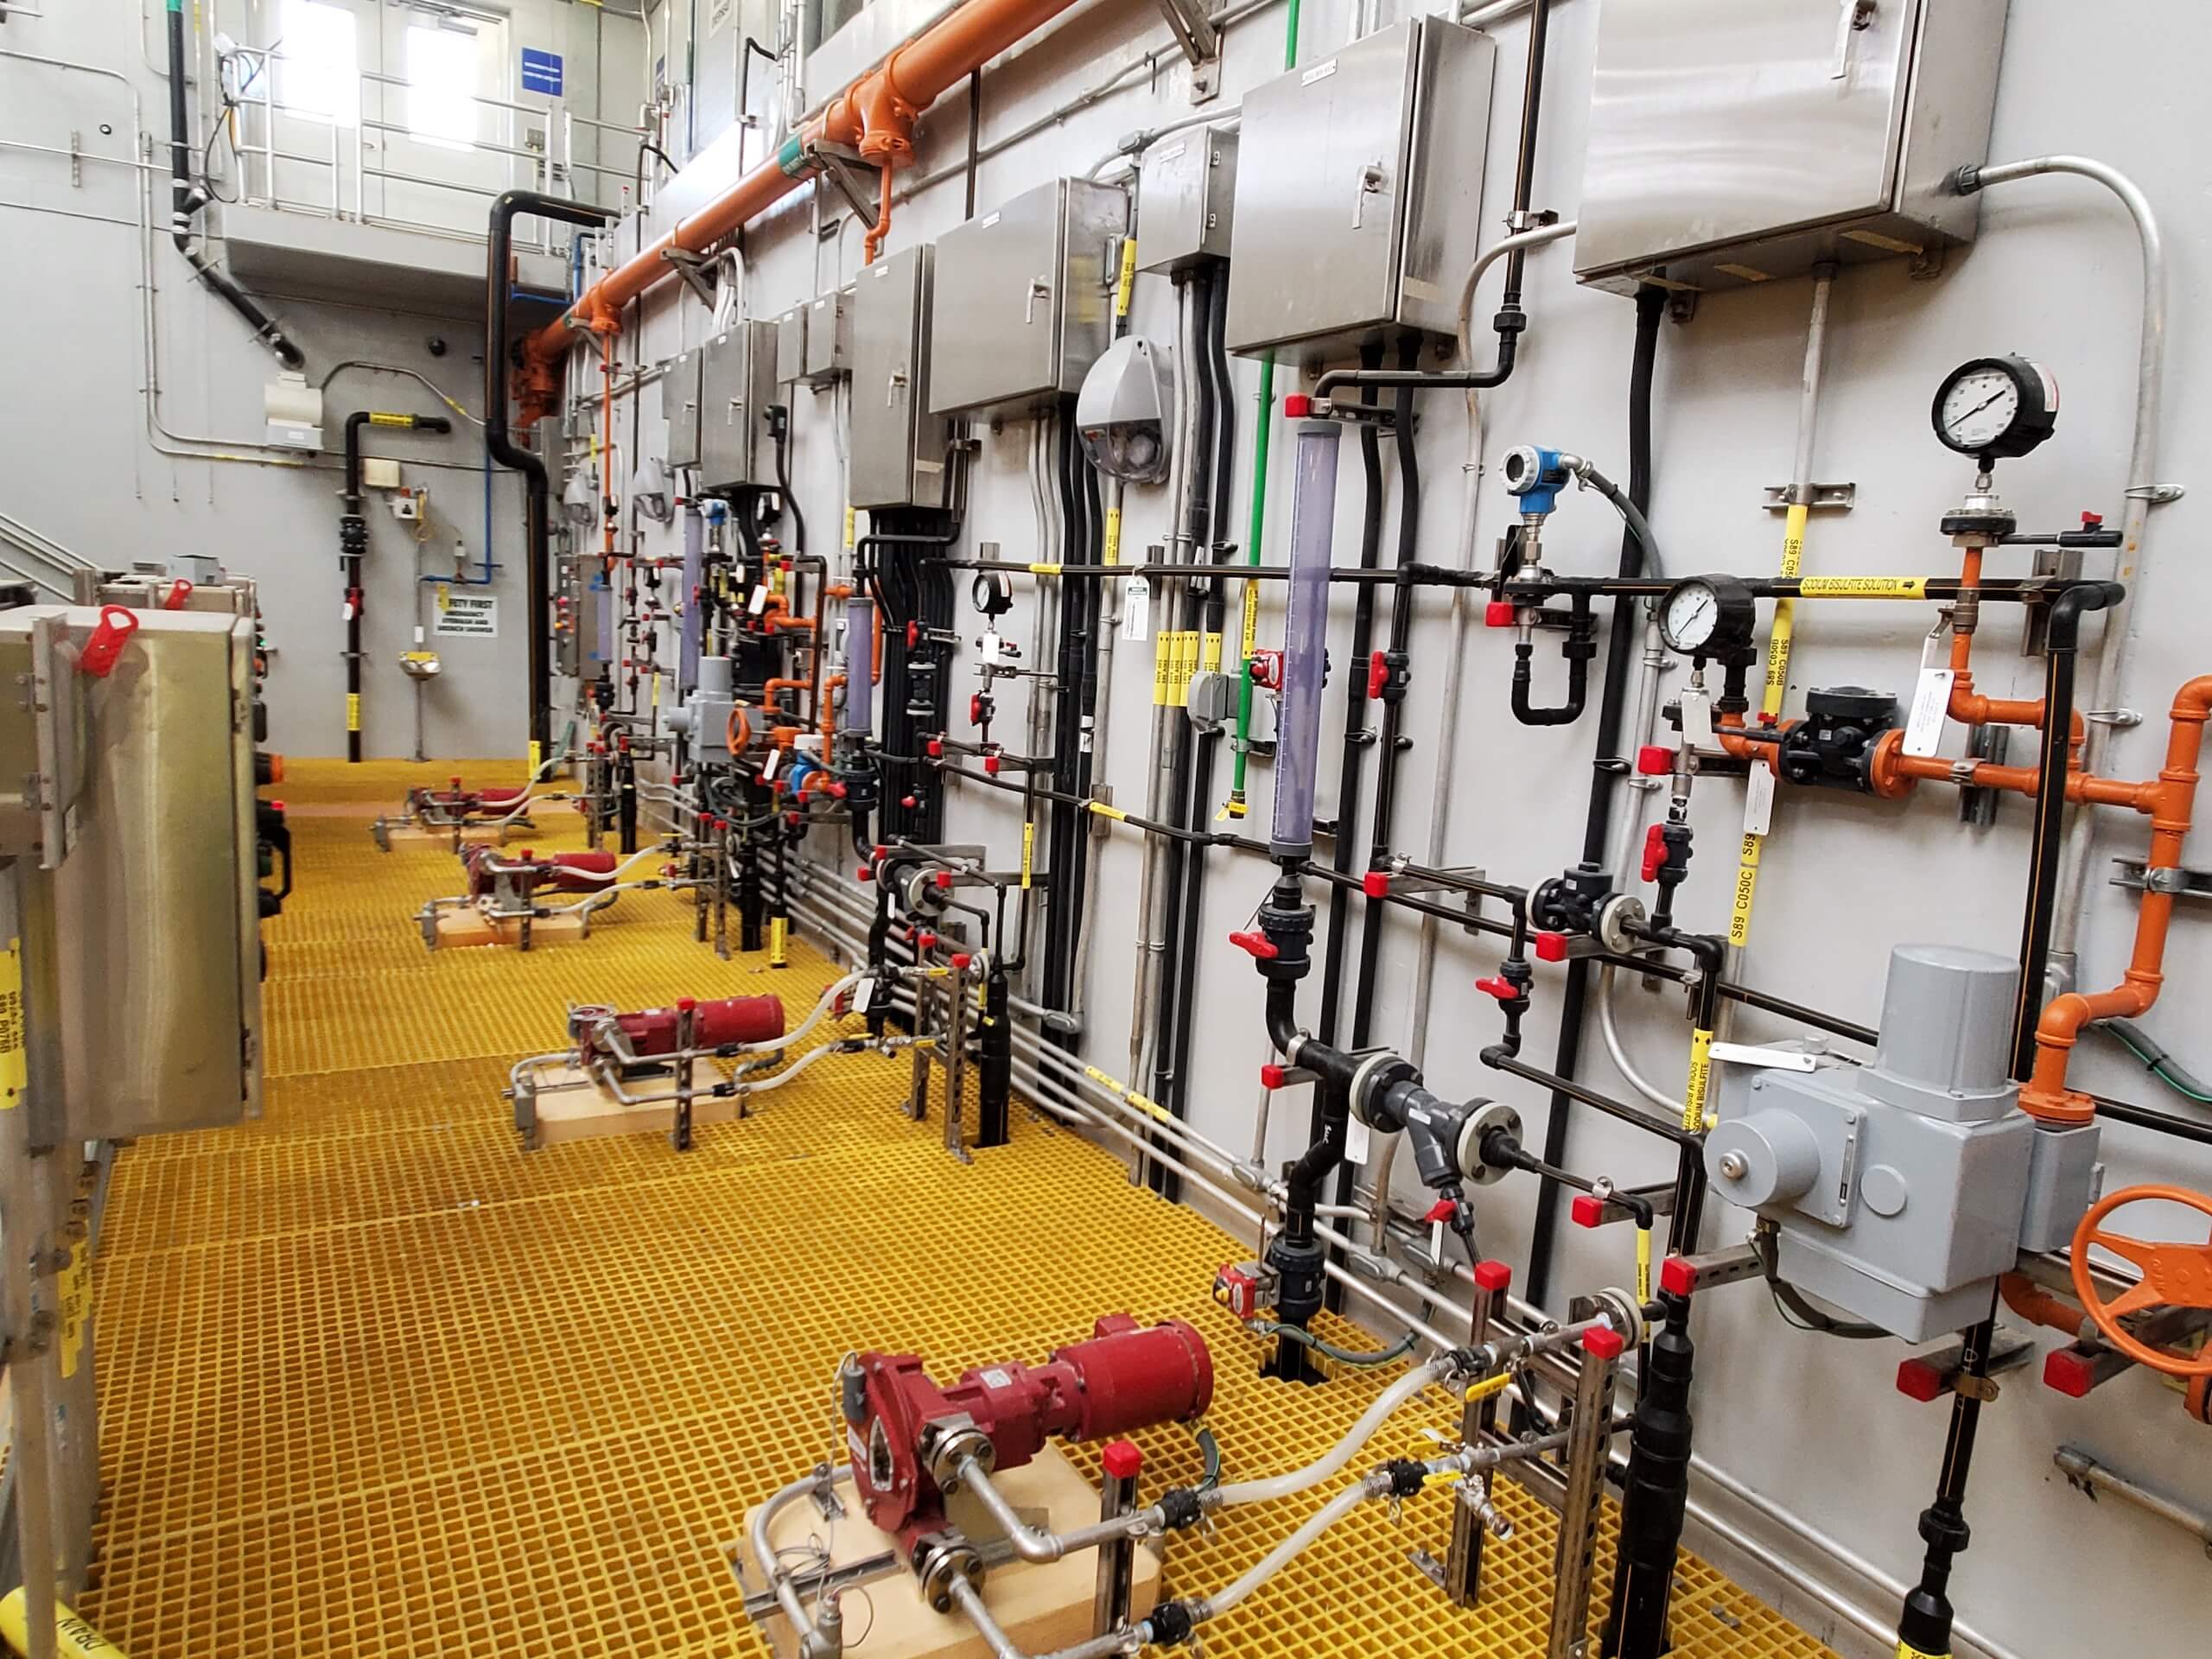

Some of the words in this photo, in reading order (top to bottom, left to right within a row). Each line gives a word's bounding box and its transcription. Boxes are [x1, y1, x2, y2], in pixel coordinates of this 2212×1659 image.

[1789, 539, 1799, 555] S89
[1802, 578, 1828, 590] SODIUM
[1828, 578, 1863, 590] BISULFITE
[1863, 578, 1898, 590] SOLUTION
[1766, 671, 1776, 686] S89
[1743, 833, 1757, 856] S89
[1736, 870, 1753, 910] C050C
[1732, 916, 1745, 938] S89
[1697, 1063, 1709, 1102] BISULFITE
[1694, 1103, 1703, 1133] SODIUM
[56, 1618, 108, 1651] DRAIN
